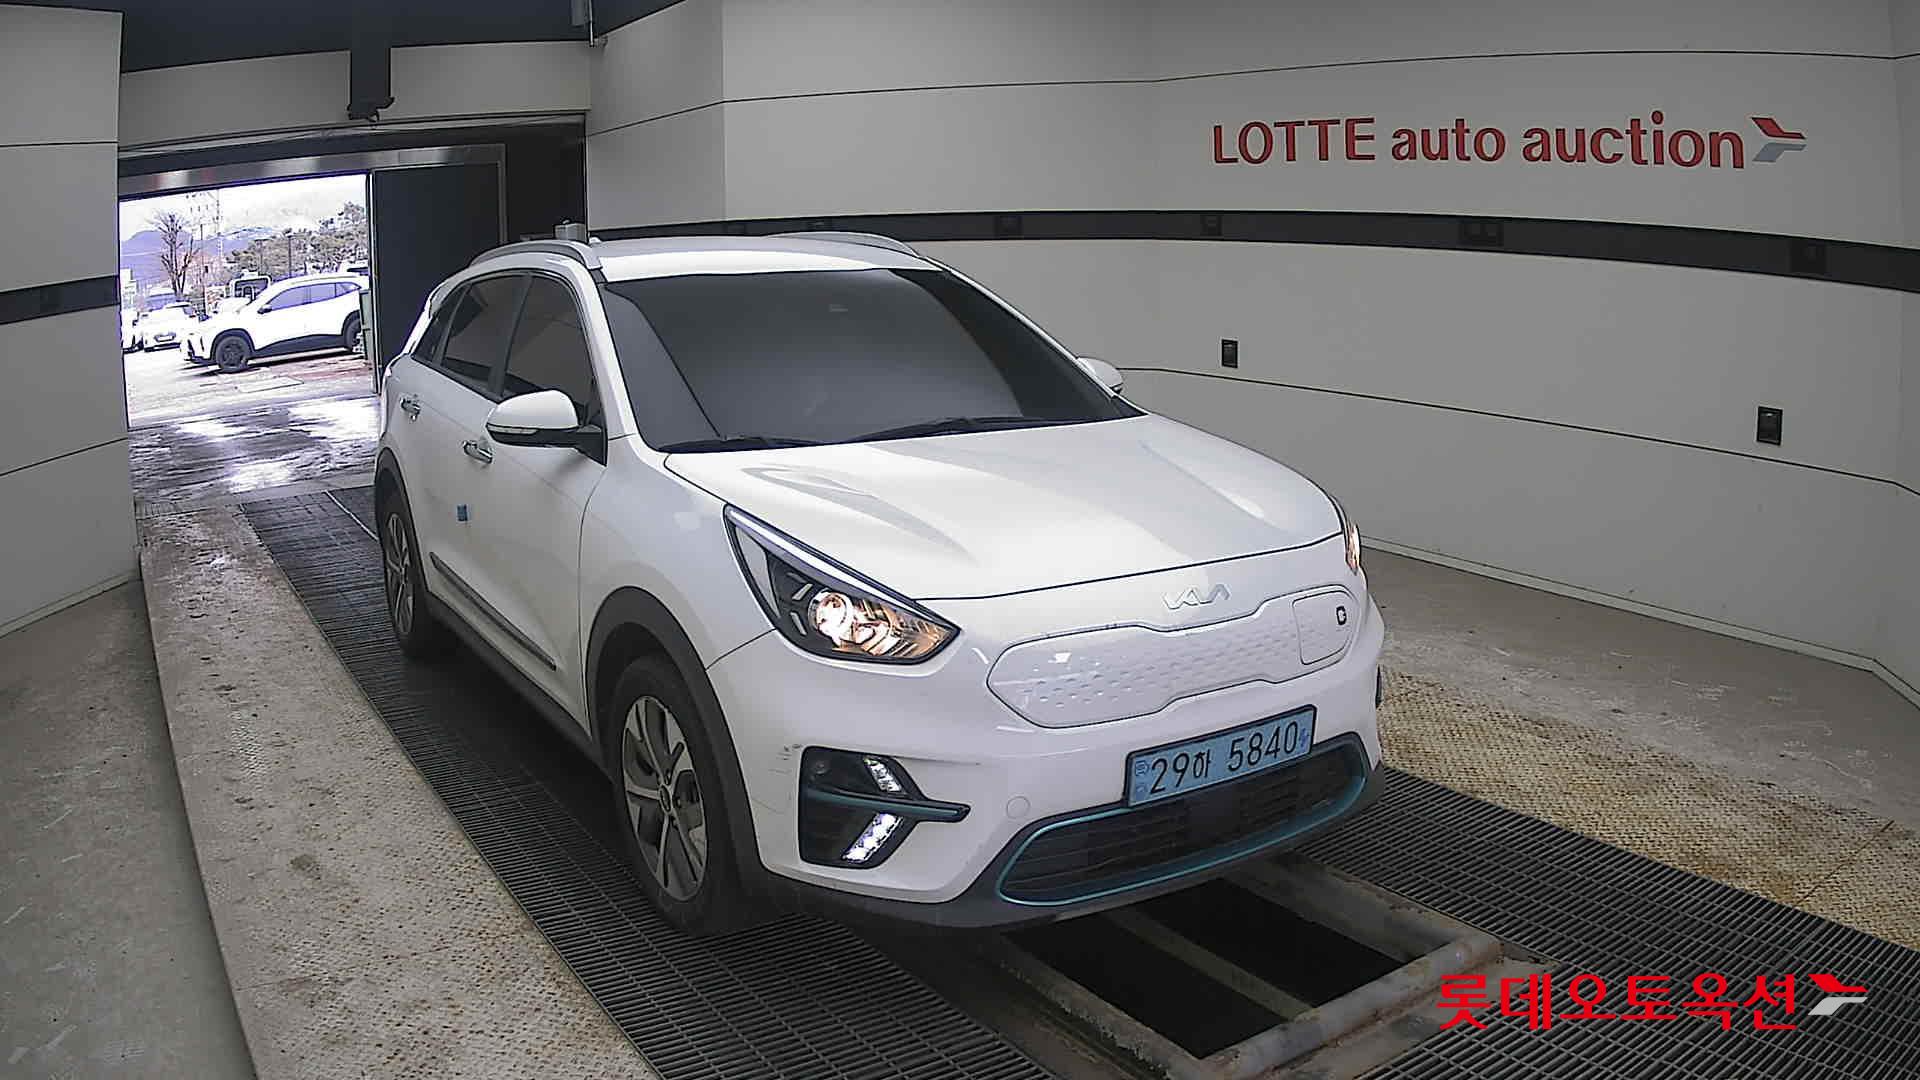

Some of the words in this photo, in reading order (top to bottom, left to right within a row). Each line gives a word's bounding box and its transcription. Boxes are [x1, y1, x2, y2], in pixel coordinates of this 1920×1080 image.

[1212, 117, 1376, 165] LOTTE
[1391, 118, 1507, 162] auto
[1521, 110, 1746, 169] auction
[1151, 749, 1211, 794] 29하
[1227, 720, 1298, 772] 5840
